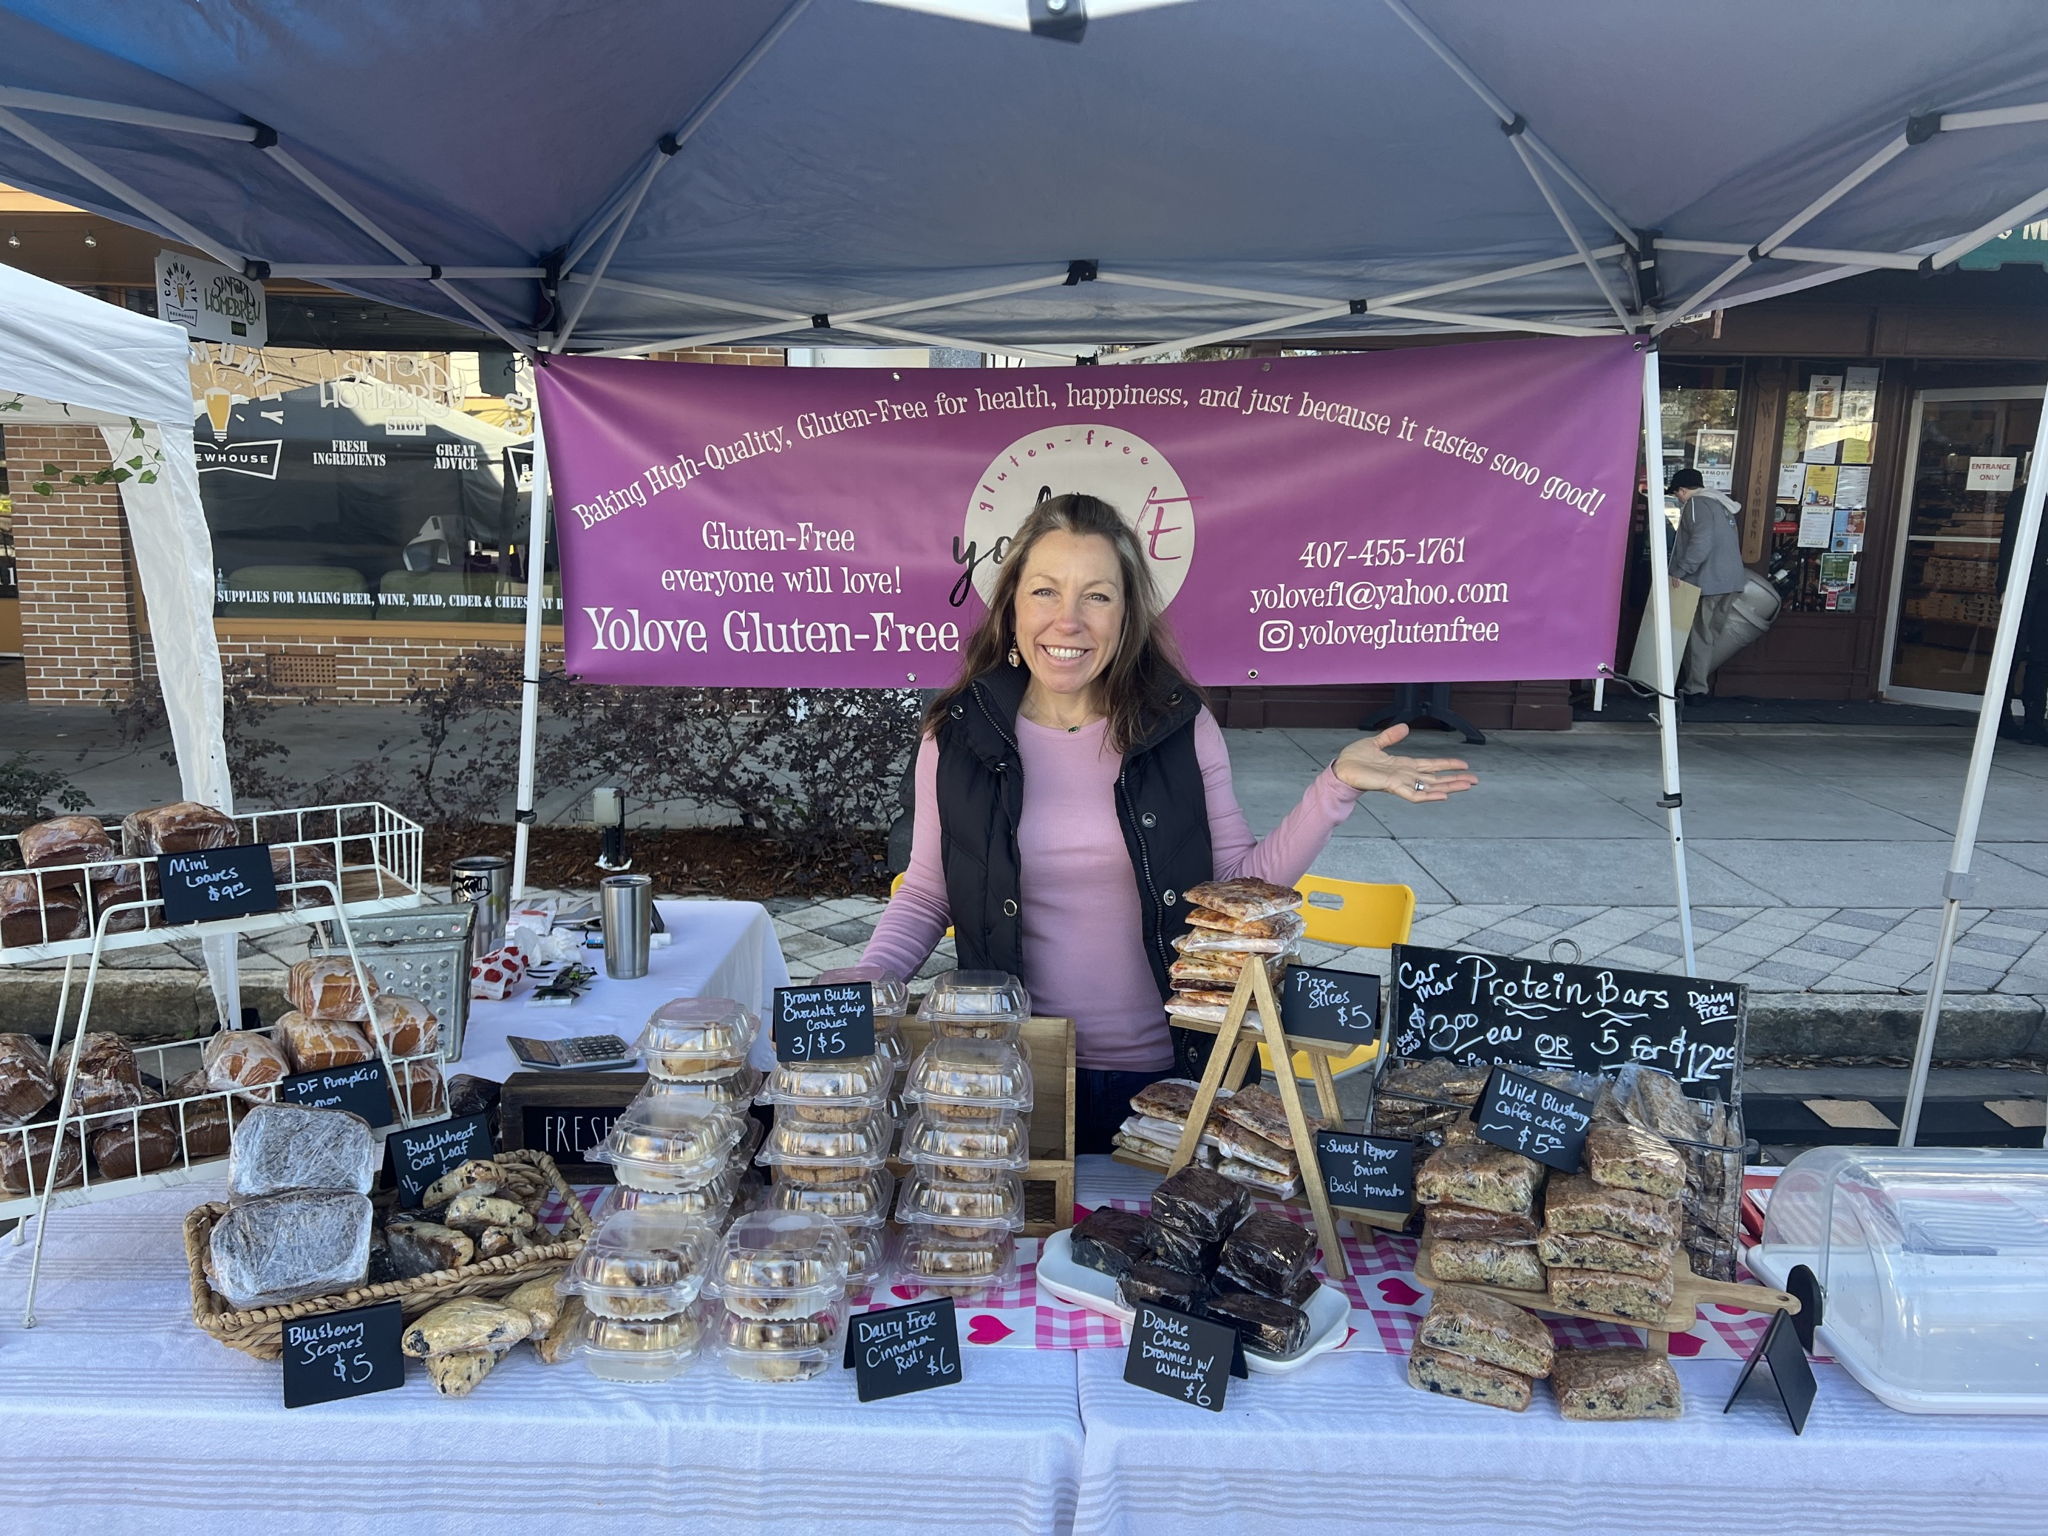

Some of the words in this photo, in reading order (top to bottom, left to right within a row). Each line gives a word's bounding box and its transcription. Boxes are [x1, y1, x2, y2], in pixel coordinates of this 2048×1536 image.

[164, 262, 198, 302] COMMUNITY
[204, 288, 260, 326] HOMEBREW
[188, 341, 284, 426] MUNITY
[332, 439, 368, 452] FRESH
[436, 444, 476, 458] GREAT
[571, 481, 648, 530] Baking
[643, 425, 792, 498] High-Quality,
[797, 398, 928, 440] Gluten-Free
[934, 392, 968, 416] for
[974, 384, 1058, 412] health,
[1066, 383, 1188, 410] happiness,
[1199, 386, 1243, 408] and
[1242, 388, 1293, 414] just
[1298, 392, 1391, 436] because
[1396, 416, 1418, 442] it
[1423, 424, 1489, 466] tastes
[1489, 452, 1540, 486] sooo
[1540, 475, 1606, 517] good!
[195, 453, 269, 464] EWHOUSE
[313, 452, 386, 467] INGREDIENTS
[434, 457, 478, 471] ADVICE
[979, 429, 1150, 512] gluten-free
[702, 520, 855, 552] Gluten-Free
[1298, 536, 1466, 568] 407-455-1761
[661, 568, 774, 597] everyone
[782, 566, 833, 594] will
[842, 565, 902, 594] love!
[218, 590, 270, 604] SUPPLIES
[272, 591, 294, 604] FOR
[298, 591, 340, 604] MAKING
[342, 592, 375, 607] BEER,
[378, 593, 410, 608] WINE,
[412, 594, 446, 608] MEAD,
[449, 594, 482, 608] CIDER
[484, 595, 492, 608] &
[495, 595, 528, 609] CHEES
[1250, 578, 1510, 614] yolovefl@yahoo.com
[582, 606, 708, 654] Yolove
[722, 610, 960, 654] Gluten-Free
[1298, 616, 1500, 650] yoloveglutenfree
[169, 855, 210, 876] Mini
[186, 867, 238, 888] Loaves
[1296, 971, 1338, 993] Pizza
[1456, 955, 1592, 1004] Protein
[1596, 971, 1670, 1009] Bars
[781, 990, 820, 1009] Brown
[1308, 990, 1350, 1009] Slices
[1687, 985, 1735, 1008] Dairy
[783, 1004, 836, 1022] Chocolate
[1696, 1003, 1729, 1020] Free
[806, 1018, 848, 1032] Cookies
[1486, 1026, 1522, 1045] ea
[1535, 1034, 1574, 1056] OR
[1590, 1030, 1620, 1055] 5
[1630, 1037, 1668, 1061] for
[299, 1096, 342, 1108] mon
[1496, 1101, 1532, 1122] Coffee
[1498, 1074, 1537, 1105] Wild
[1542, 1092, 1590, 1132] Blueberry
[546, 1116, 618, 1153] FRESH
[411, 1152, 436, 1170] Oat
[439, 1140, 468, 1160] Loaf
[1364, 1140, 1398, 1162] Pepper
[1330, 1176, 1358, 1194] Basil
[1363, 1184, 1404, 1198] tomato
[859, 1321, 903, 1342] Dairy
[906, 1311, 938, 1332] Free
[1142, 1309, 1188, 1337] Double
[300, 1336, 363, 1365] Scones
[866, 1335, 935, 1368] Cinnamon
[1152, 1330, 1190, 1352] Choco
[1198, 1356, 1214, 1372] w/
[1184, 1382, 1212, 1406] $6
